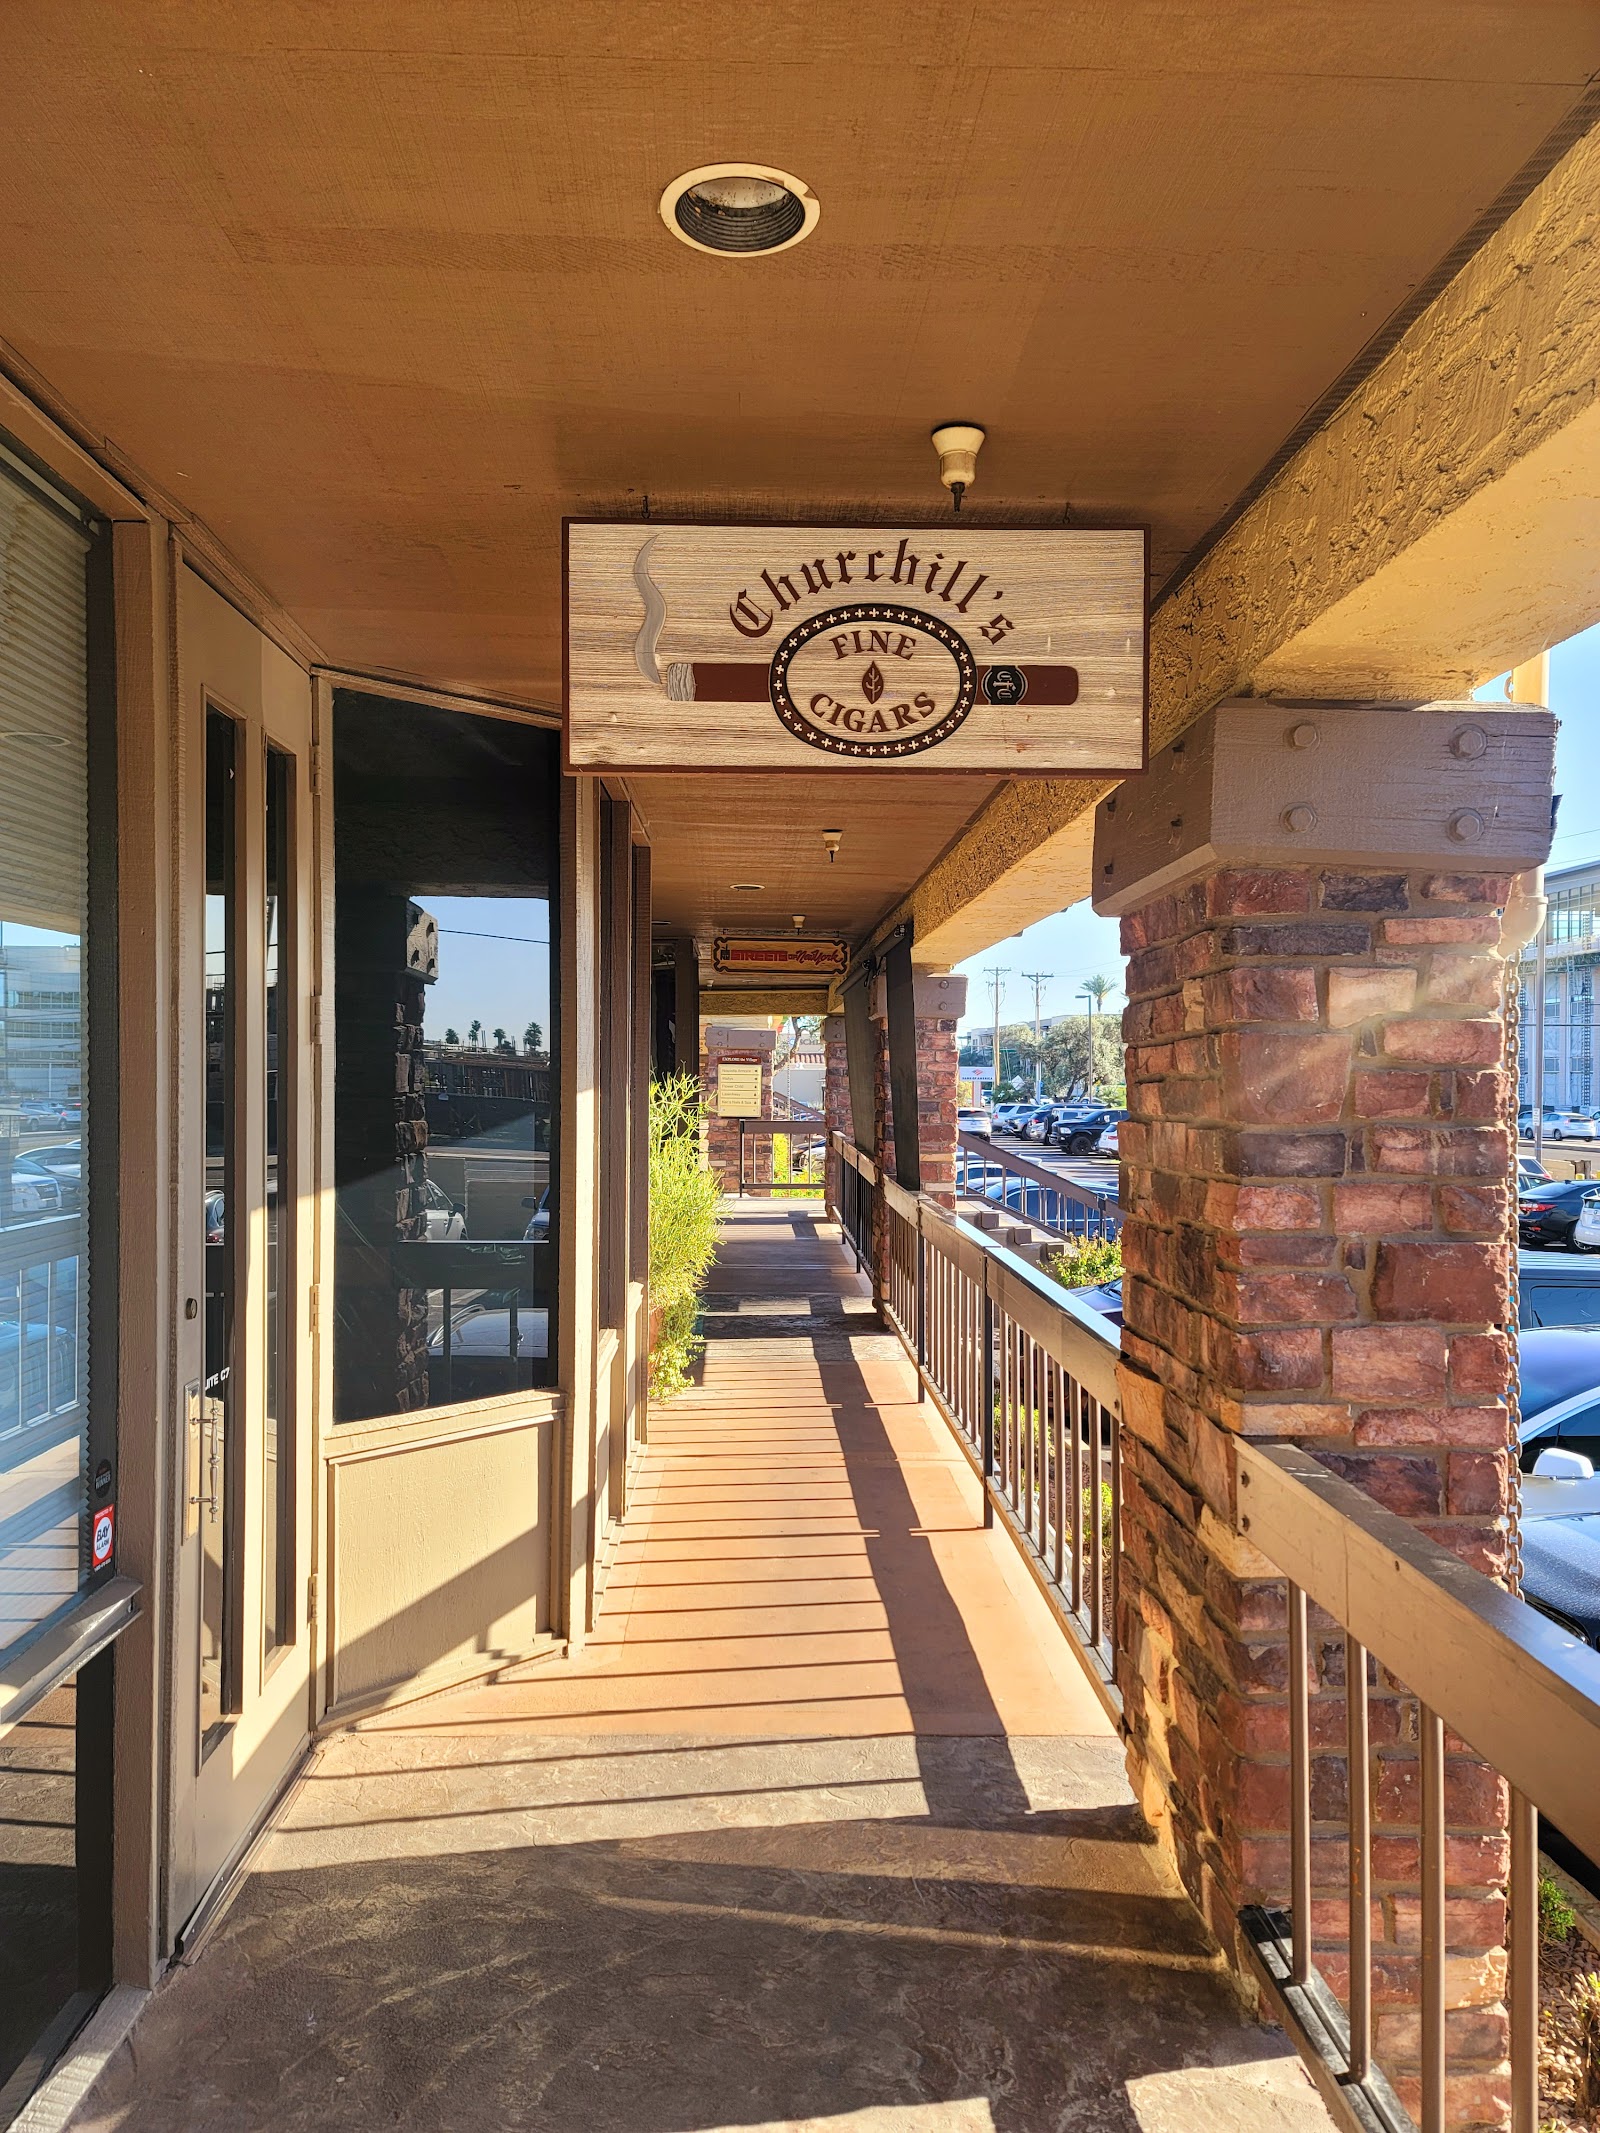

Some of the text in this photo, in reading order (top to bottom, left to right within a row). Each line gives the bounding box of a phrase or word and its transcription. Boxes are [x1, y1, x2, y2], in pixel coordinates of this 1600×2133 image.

[730, 538, 1015, 645] Churchill's
[830, 630, 917, 660] FINE
[810, 692, 936, 733] CIGARS
[205, 1367, 230, 1390] UITE C7
[96, 1523, 110, 1543] BAY
